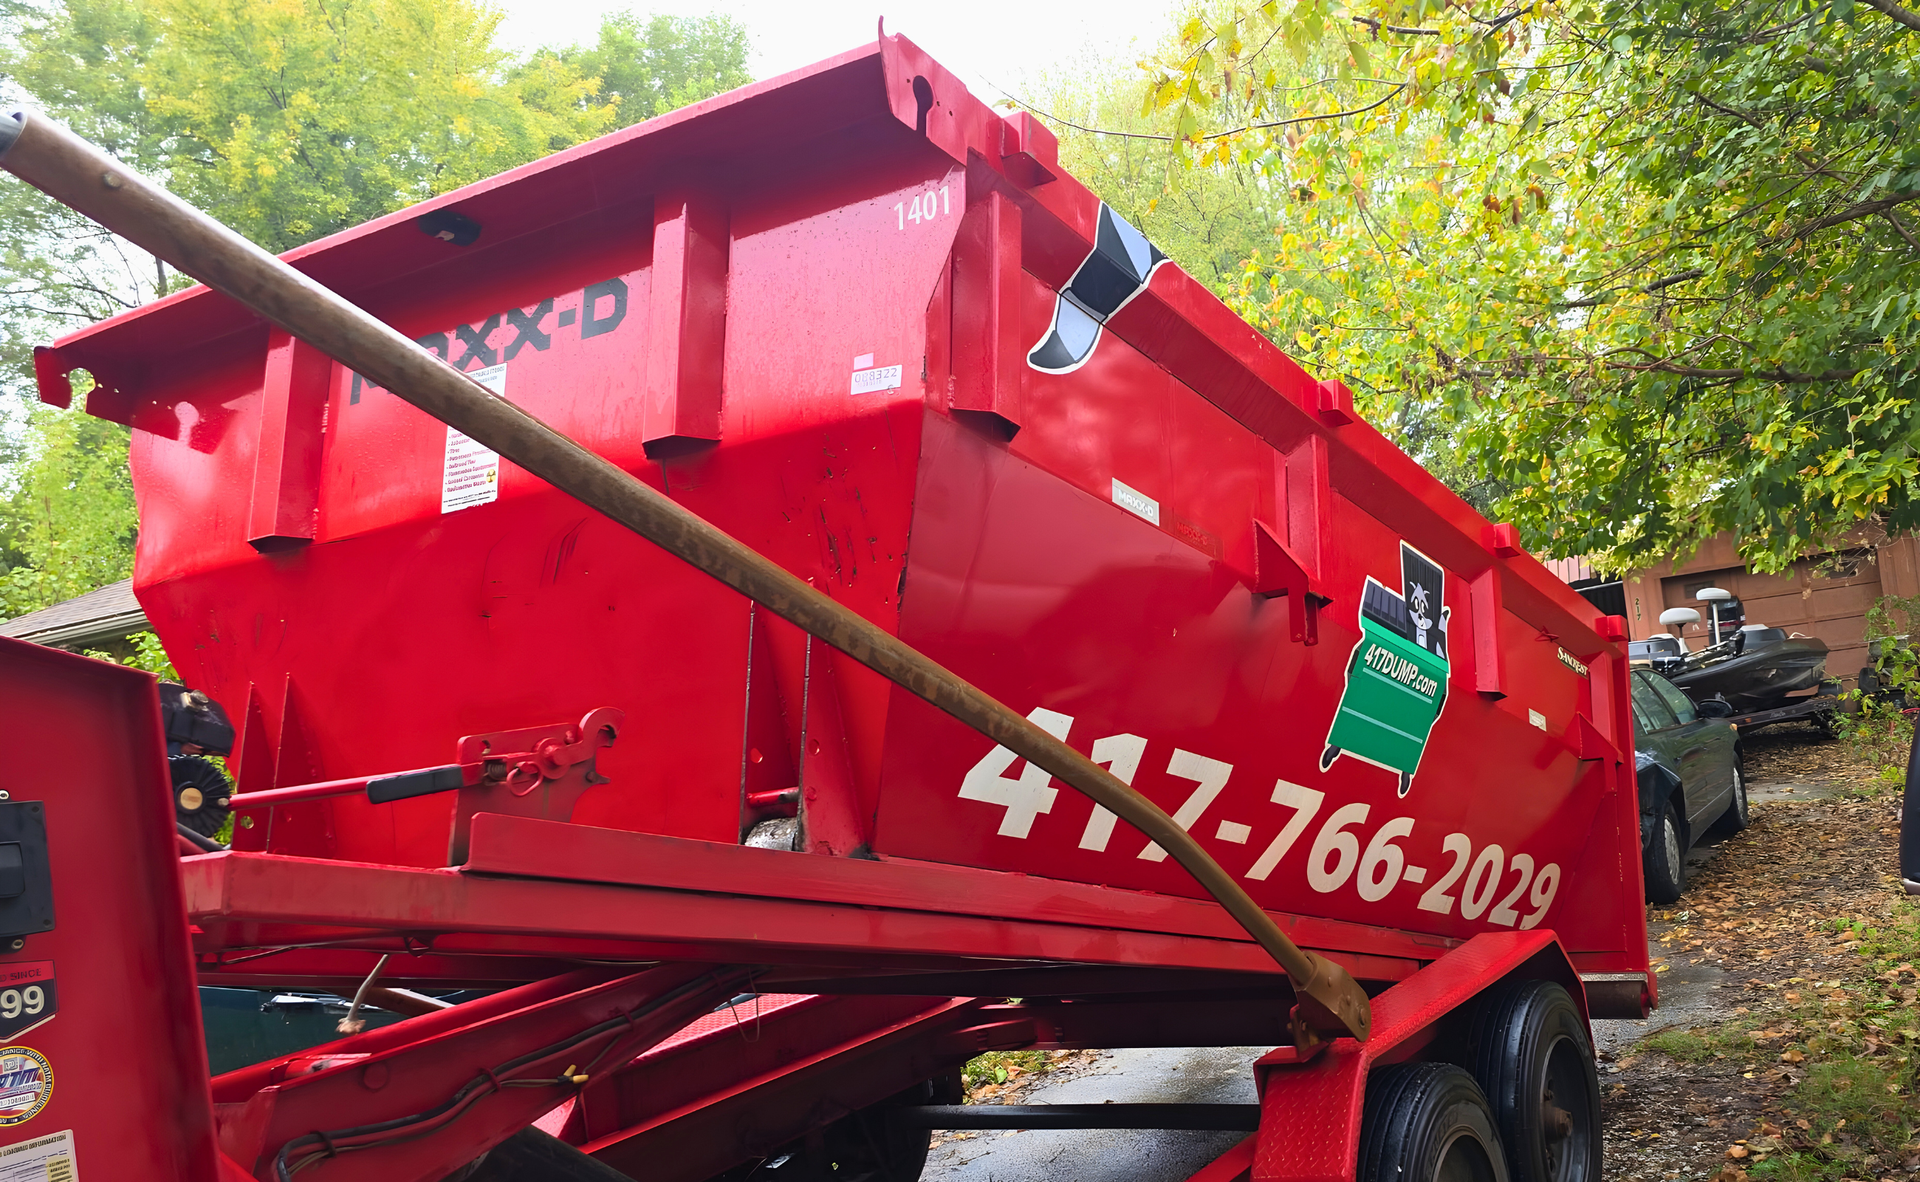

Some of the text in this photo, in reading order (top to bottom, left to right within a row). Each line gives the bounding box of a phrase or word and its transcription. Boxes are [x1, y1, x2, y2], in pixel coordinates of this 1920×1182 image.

[894, 185, 950, 231] 1401
[1364, 643, 1438, 697] 417DUMP.com
[957, 706, 1561, 930] 417-766-2029
[10, 968, 42, 981] SINCE
